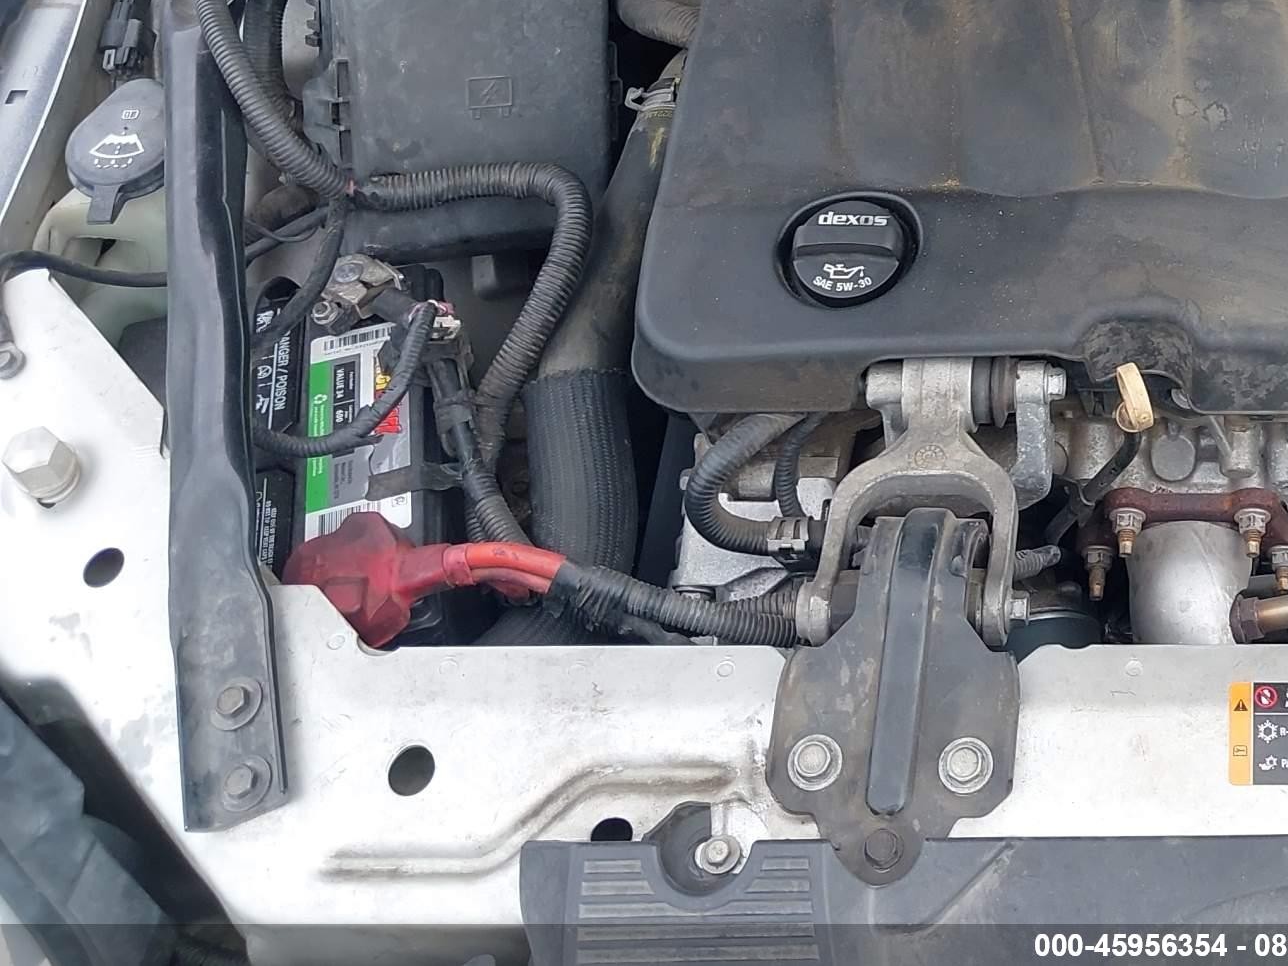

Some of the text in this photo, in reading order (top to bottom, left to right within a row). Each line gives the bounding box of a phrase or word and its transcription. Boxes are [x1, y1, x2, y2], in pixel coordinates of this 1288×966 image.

[818, 211, 890, 226] dexos
[812, 276, 873, 292] SAE 5W-30
[336, 369, 344, 399] VALUE 34
[274, 375, 288, 410] POISON
[335, 410, 344, 423] 600
